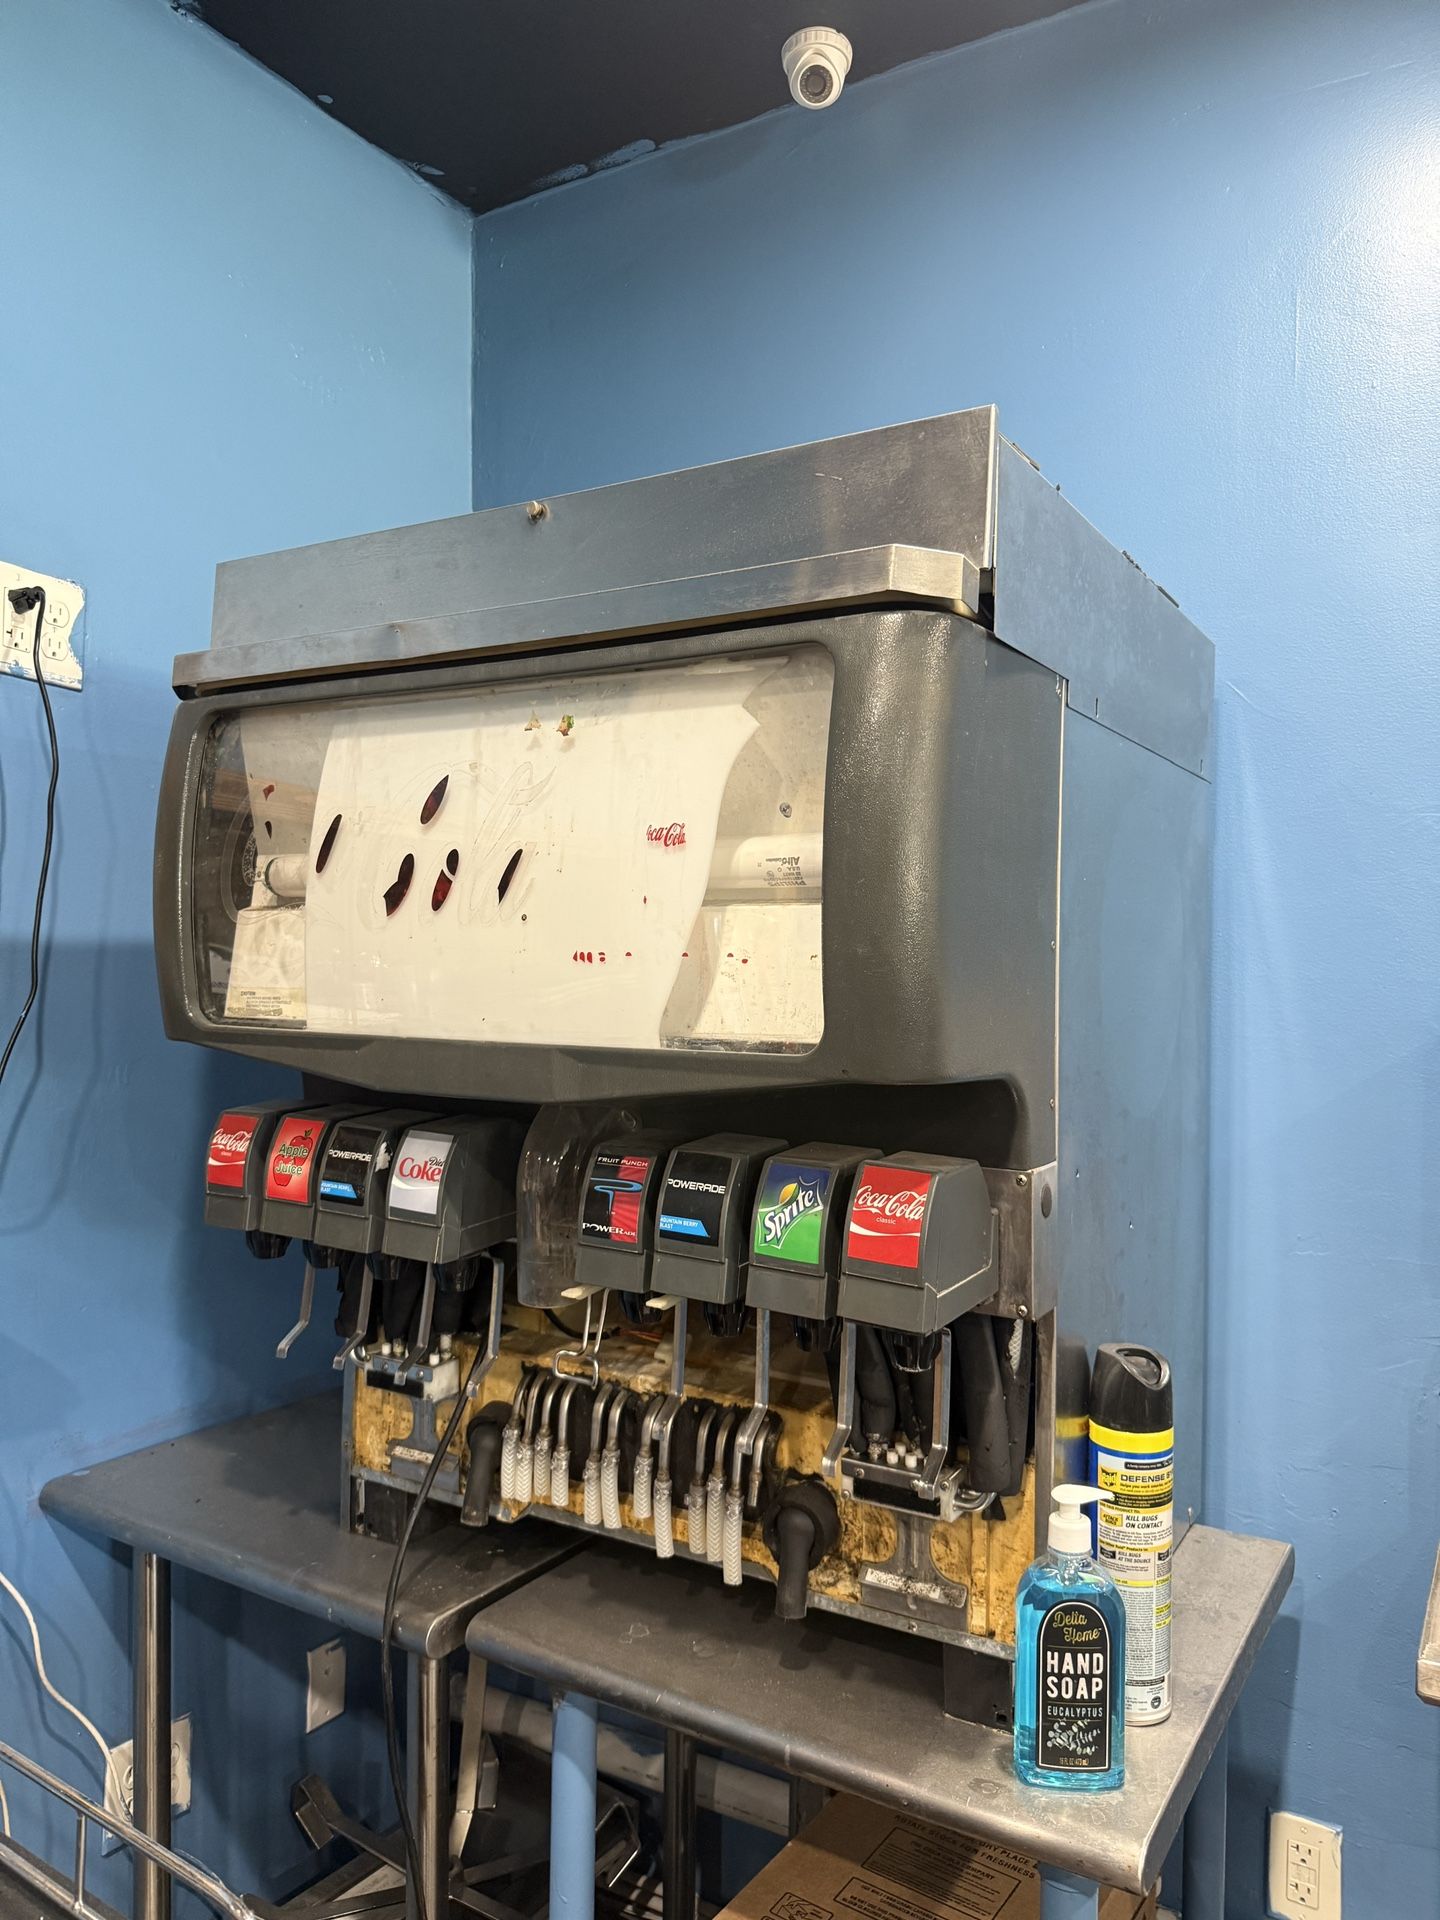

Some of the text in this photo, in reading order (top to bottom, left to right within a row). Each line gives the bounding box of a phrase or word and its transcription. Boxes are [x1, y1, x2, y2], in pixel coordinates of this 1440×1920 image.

[280, 1144, 308, 1158] Apple
[275, 1162, 303, 1175] Juice
[399, 1157, 442, 1182] Coke
[597, 1156, 649, 1167] FRUIT PUNCH
[854, 1185, 928, 1221] Coca-Cola
[763, 1188, 815, 1244] Sprite
[875, 1216, 897, 1225] classic
[1120, 1473, 1165, 1483] DEFENSE
[1137, 1521, 1163, 1529] CONTACT
[1063, 1627, 1101, 1644] Home
[1046, 1651, 1104, 1675] HAND
[1046, 1675, 1103, 1700] SOAP
[1047, 1705, 1103, 1718] EUCALYPTUS
[980, 1851, 1036, 1879] FRESHNESS
[1000, 1849, 1031, 1867] PLACE
